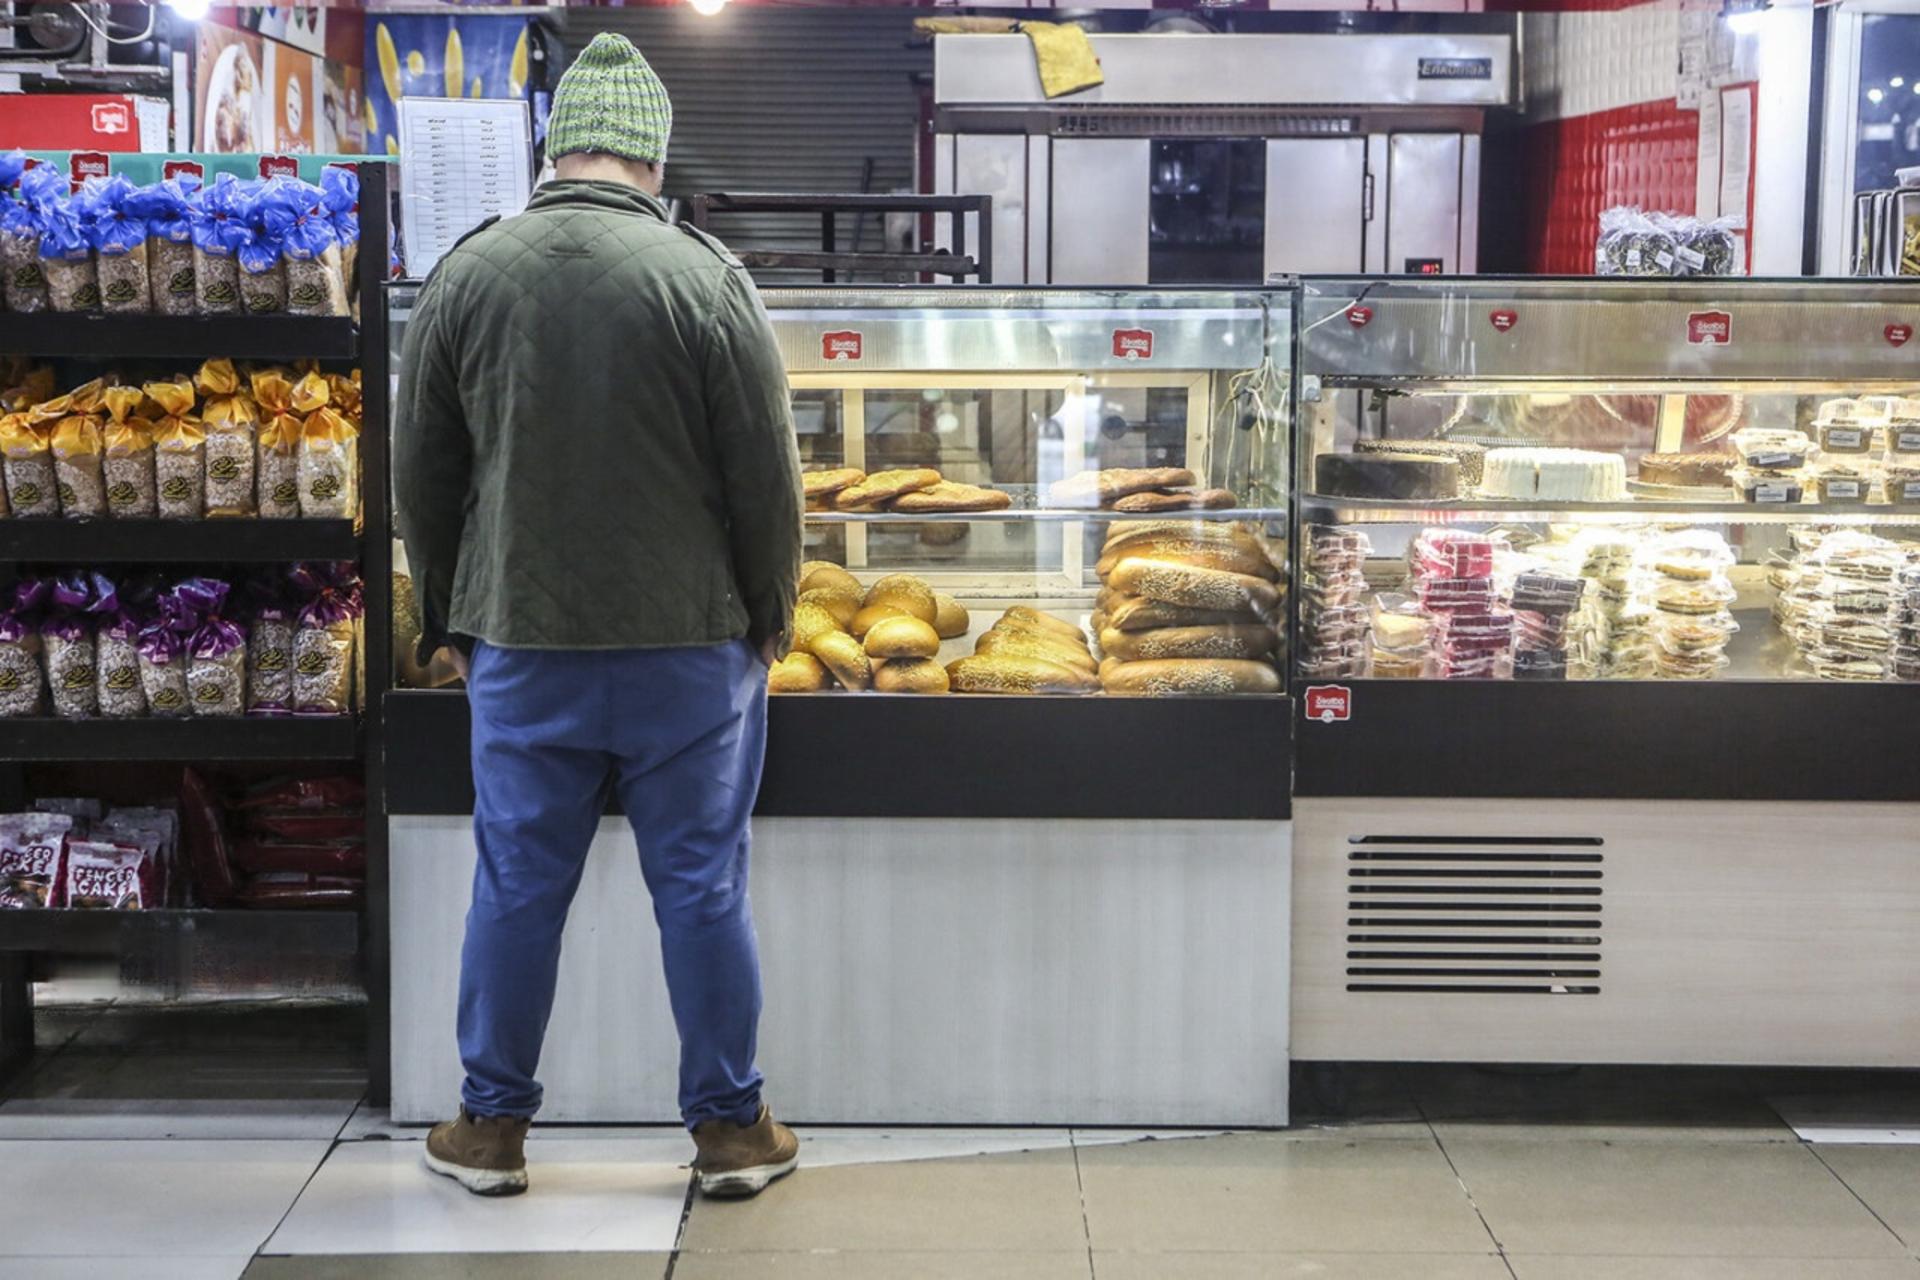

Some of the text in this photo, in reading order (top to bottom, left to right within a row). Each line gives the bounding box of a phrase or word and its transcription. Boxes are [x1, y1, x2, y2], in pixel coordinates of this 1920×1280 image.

[3, 847, 52, 862] FIGER
[76, 868, 133, 883] FINGER
[78, 880, 128, 897] CAKE
